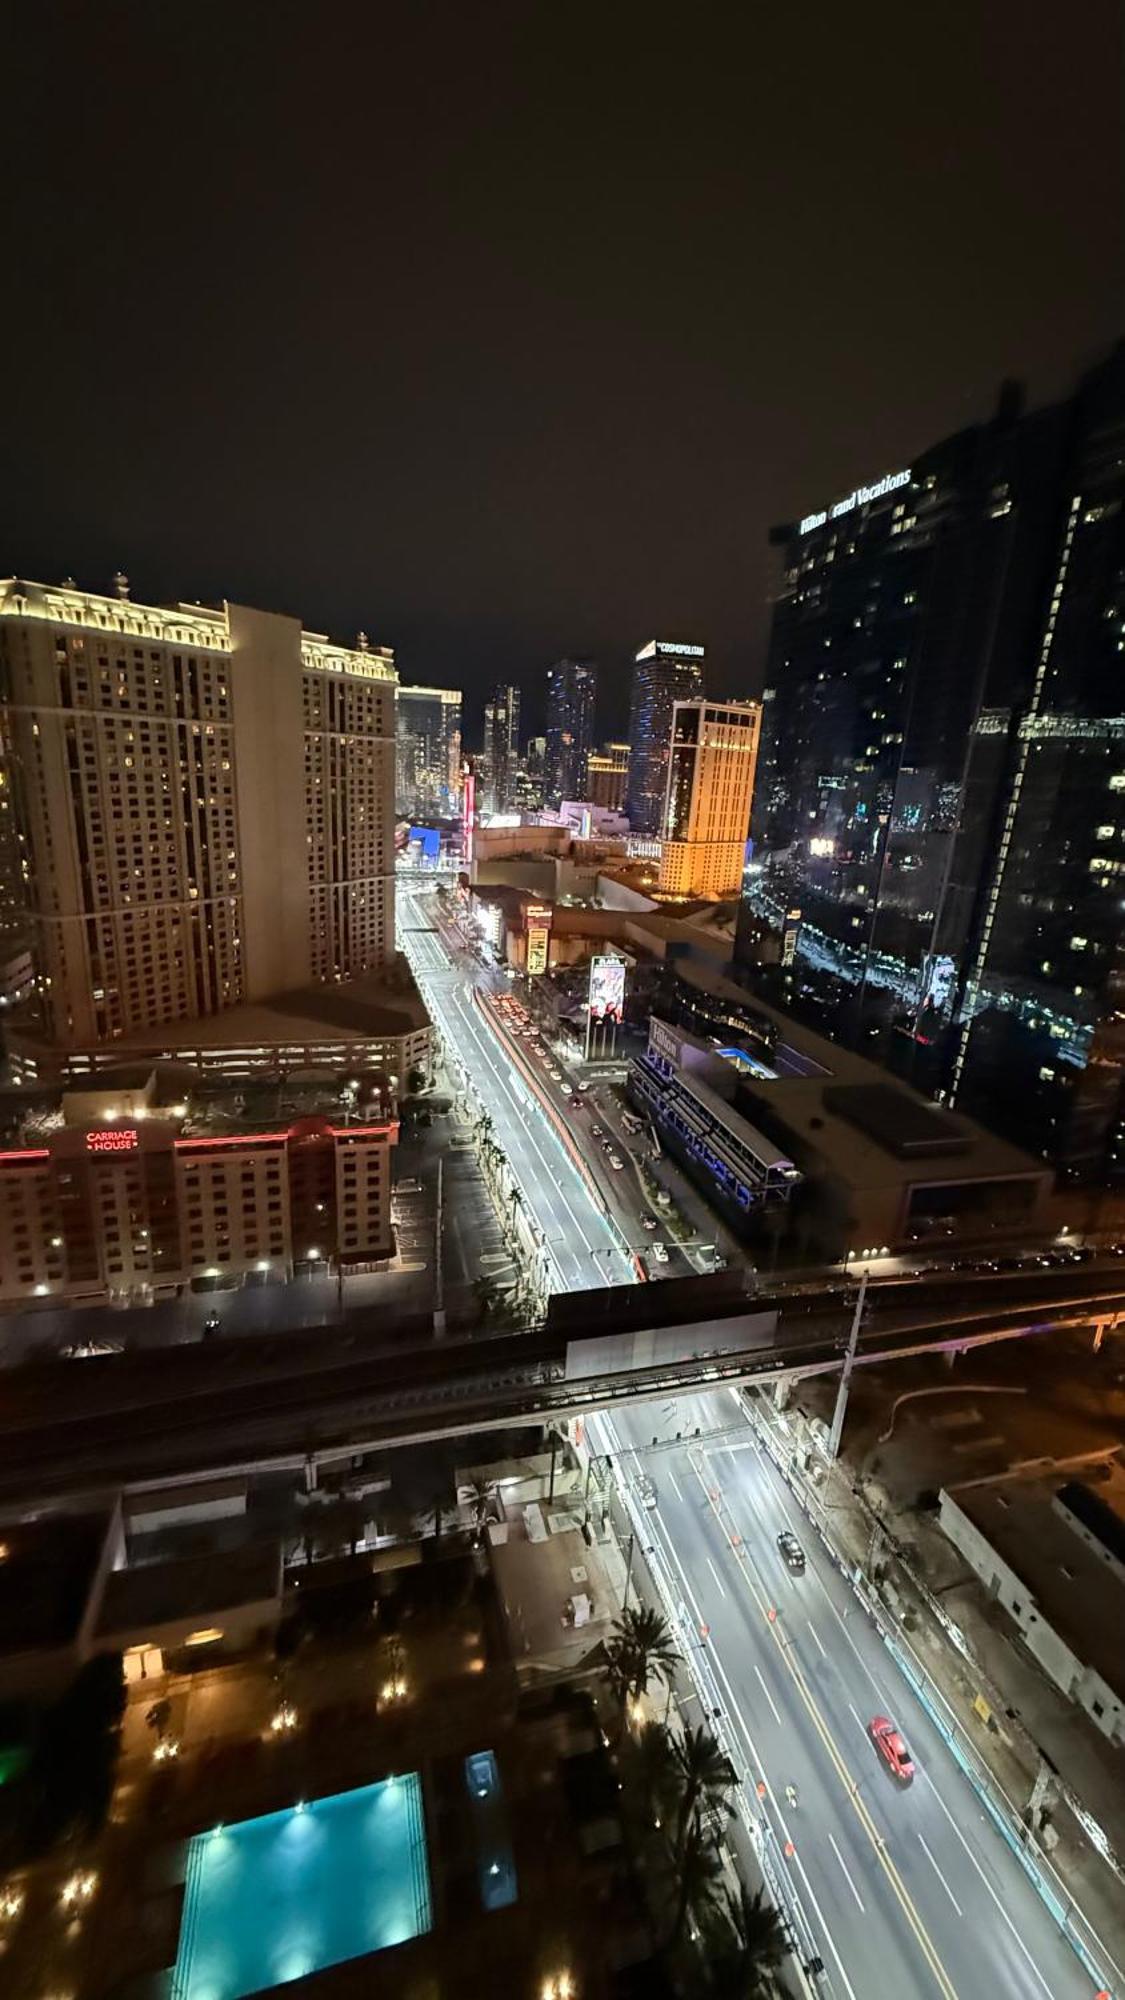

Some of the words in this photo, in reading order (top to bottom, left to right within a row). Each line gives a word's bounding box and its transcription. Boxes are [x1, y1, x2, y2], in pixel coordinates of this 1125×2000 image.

[800, 512, 827, 535] Hilton
[857, 469, 911, 505] Vacations
[86, 1130, 137, 1142] CARRIAGE
[94, 1140, 131, 1151] HOUSE
